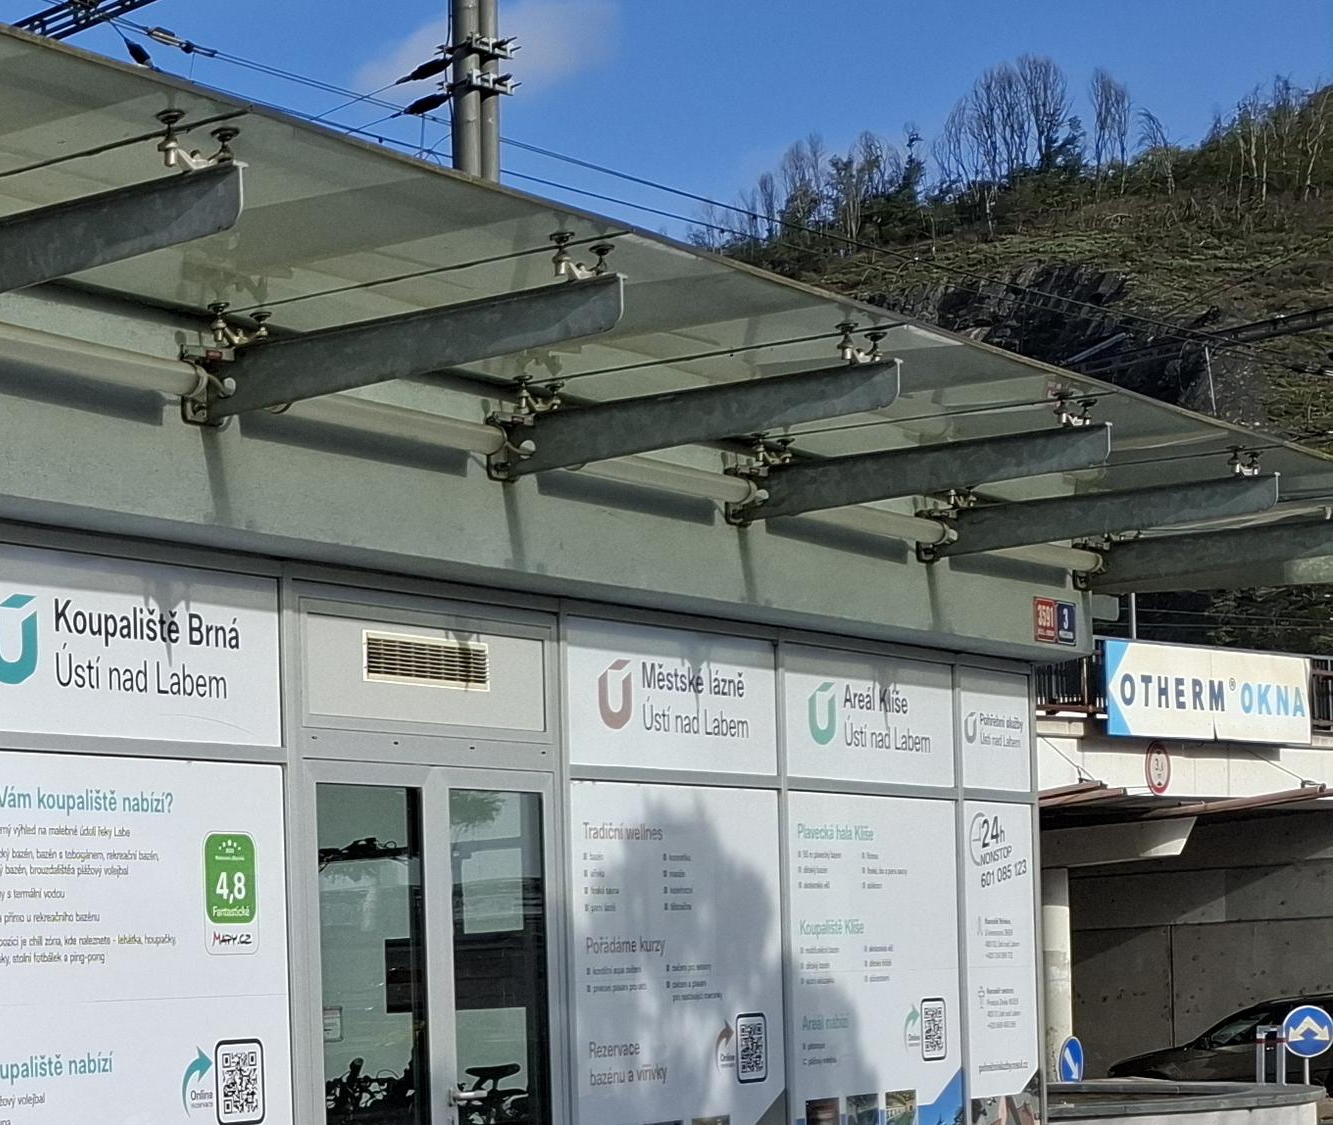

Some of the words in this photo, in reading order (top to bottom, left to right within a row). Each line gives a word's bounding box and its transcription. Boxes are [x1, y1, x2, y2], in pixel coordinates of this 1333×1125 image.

[54, 598, 180, 646] Koupaliště
[188, 613, 240, 650] Brná
[1063, 608, 1068, 630] 3
[55, 643, 101, 688] Ústí
[108, 659, 148, 694] nad
[156, 660, 228, 700] Labem
[642, 661, 704, 694] Městské
[709, 668, 745, 698] lázně
[844, 683, 876, 711] Areál
[879, 687, 909, 714] Klíše
[1240, 682, 1306, 718] OKNA
[643, 696, 671, 733] Ústí
[676, 709, 699, 735] nad
[704, 710, 749, 739] Labem
[844, 716, 867, 748] Ústí
[870, 726, 891, 752] nad
[894, 726, 931, 754] Labem
[37, 787, 118, 817] koupaliště
[123, 791, 174, 814] nabízí?
[981, 816, 1005, 848] 24h
[980, 845, 1012, 865] NONSTOP
[216, 872, 245, 904] 4,8
[981, 870, 995, 887] 601
[997, 864, 1012, 882] 085
[639, 936, 666, 957] kurzy
[69, 1050, 114, 1075] nabízí
